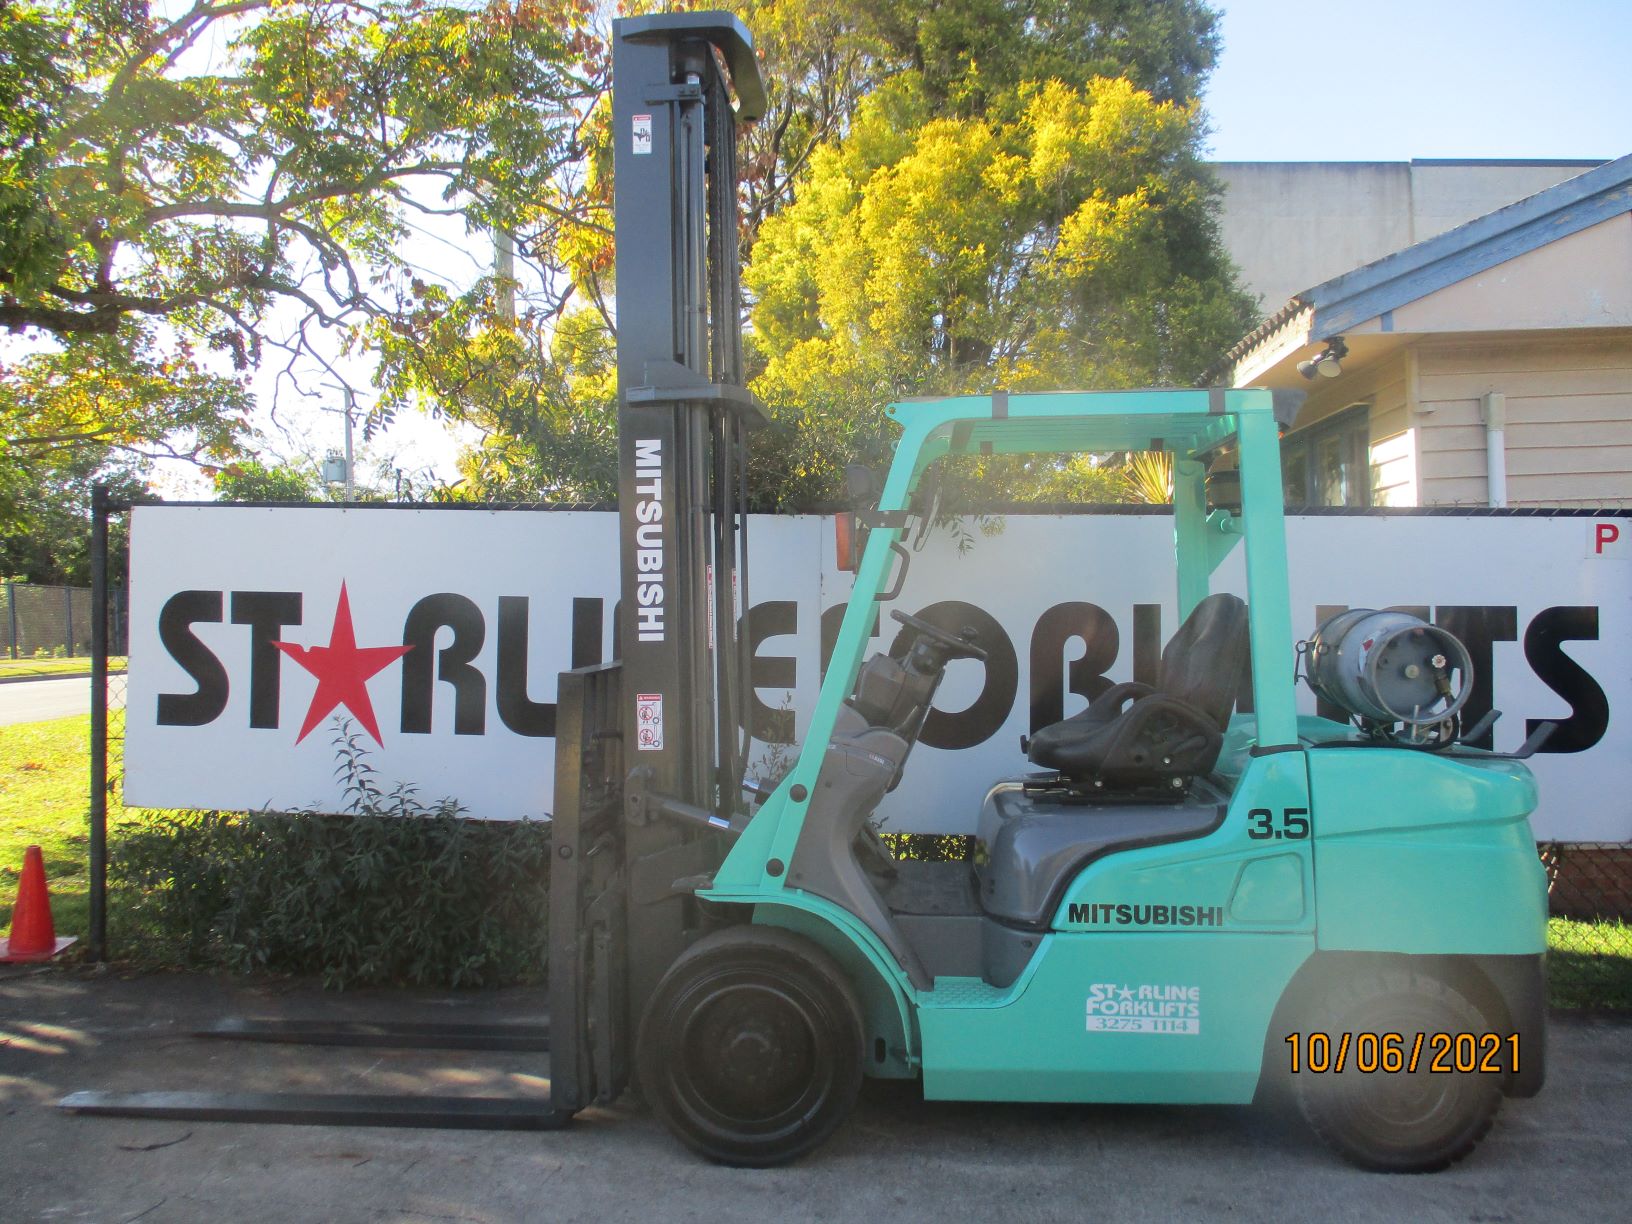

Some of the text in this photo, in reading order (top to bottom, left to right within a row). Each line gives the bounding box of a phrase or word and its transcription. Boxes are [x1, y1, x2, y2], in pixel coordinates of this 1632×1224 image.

[635, 439, 665, 642] MITSUBISHI
[1595, 523, 1620, 554] P
[1247, 807, 1310, 840] 3.5
[1068, 903, 1223, 927] MITSUBISHI
[1086, 999, 1200, 1017] FORKLIFTS
[1095, 1018, 1189, 1032] 3275 1114
